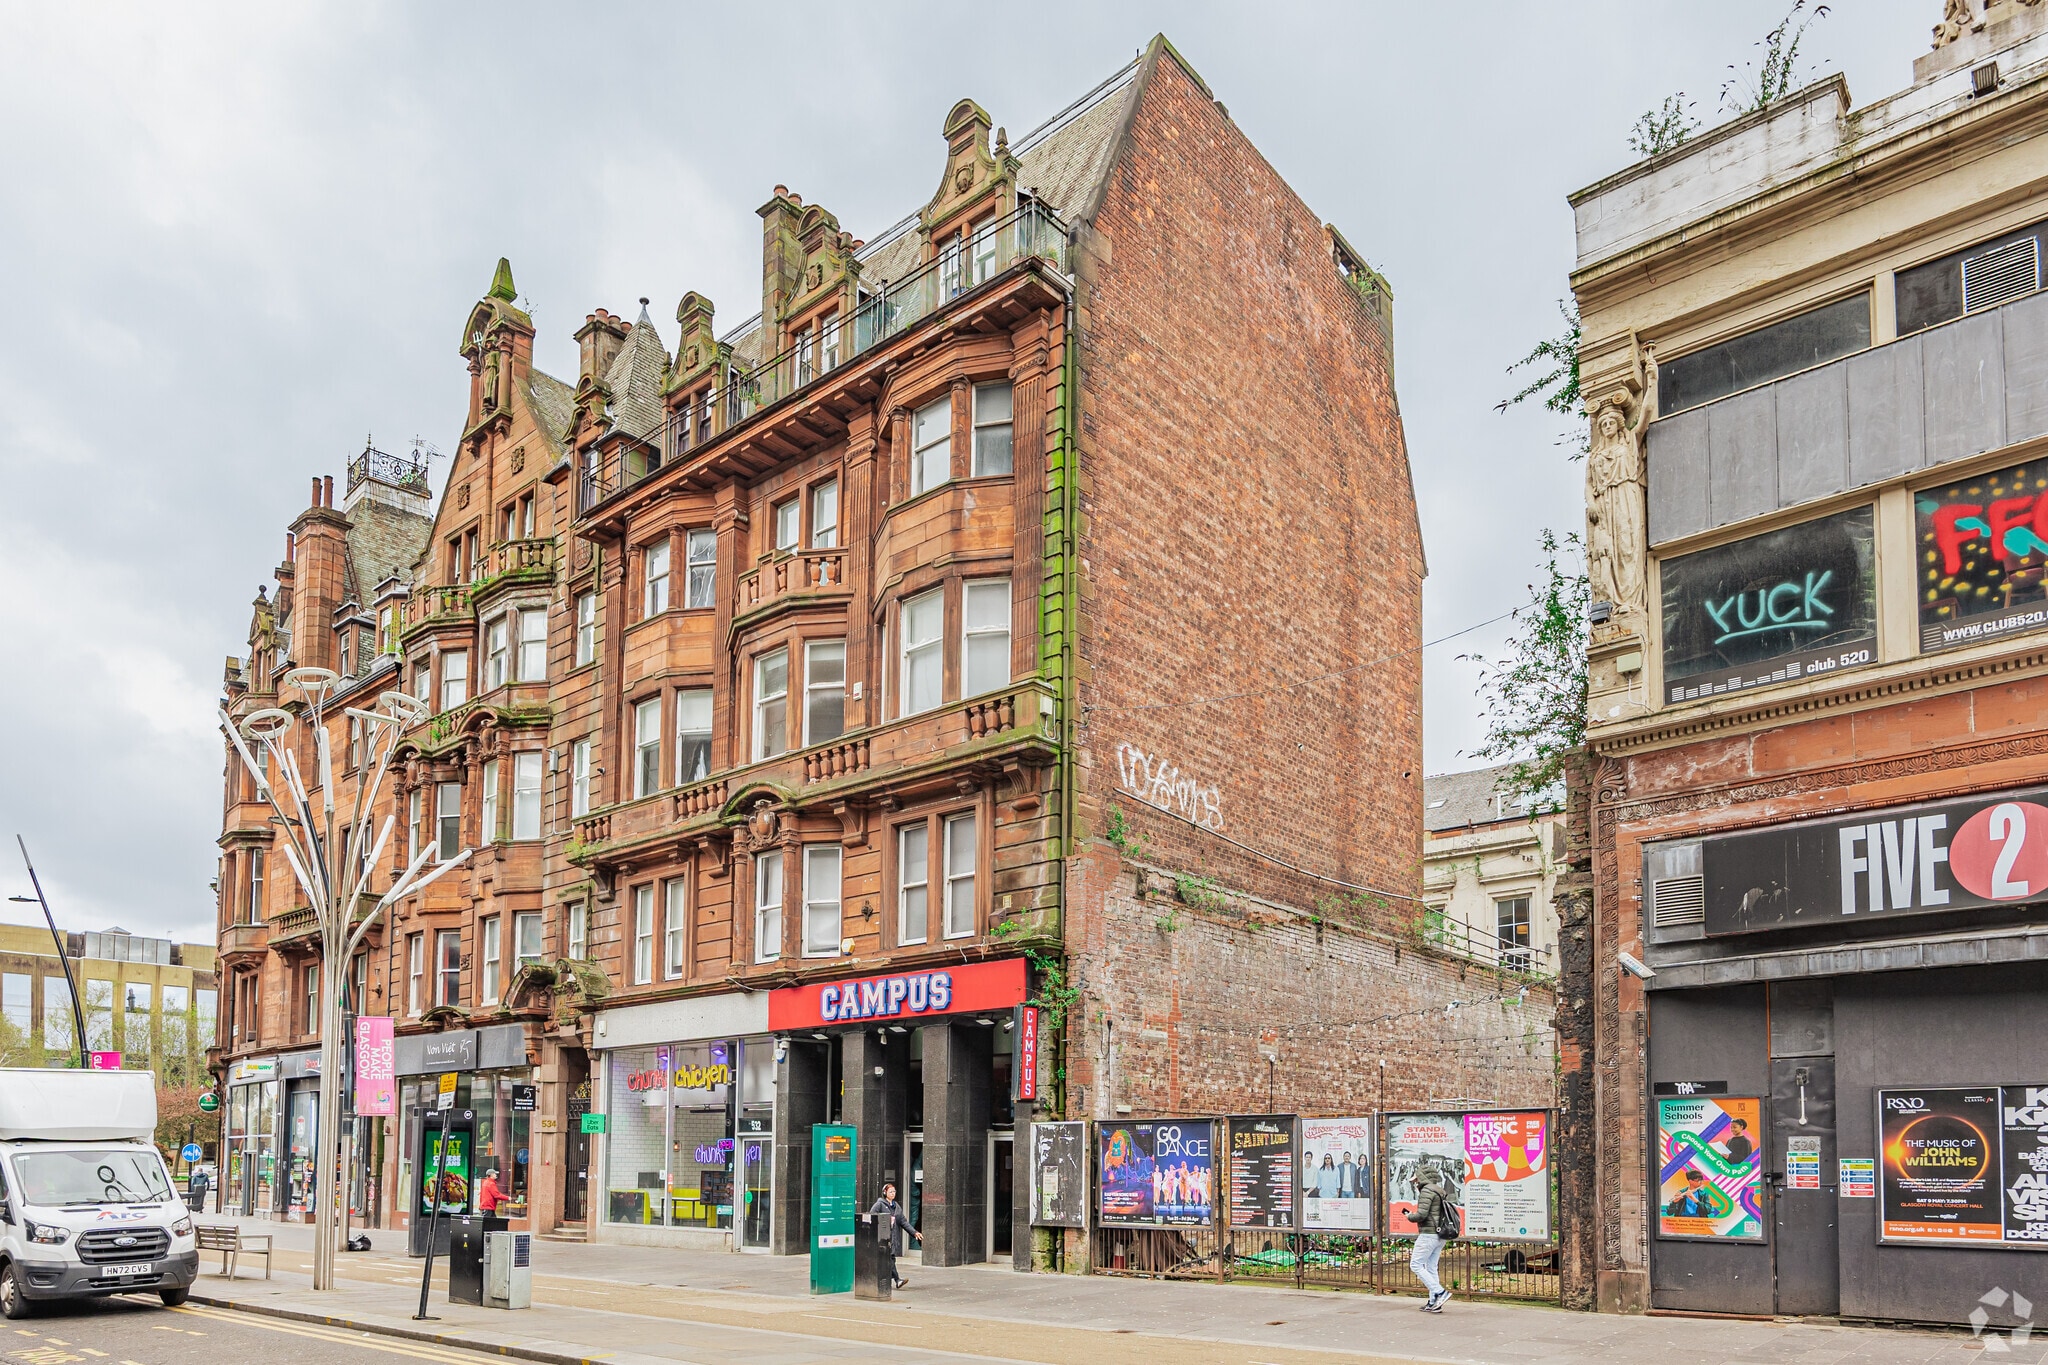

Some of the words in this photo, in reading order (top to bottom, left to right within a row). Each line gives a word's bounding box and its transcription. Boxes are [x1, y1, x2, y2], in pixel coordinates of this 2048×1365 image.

[1706, 570, 1833, 633] YUCK
[1943, 611, 2048, 640] WWW.CLUB520.
[1807, 658, 1835, 674] club
[1841, 650, 1869, 666] 520
[1839, 813, 1950, 914] FIVE
[821, 971, 953, 1021] CAMPUS
[360, 1022, 370, 1080] GLASGOW
[1025, 1010, 1034, 1096] CAMPUS
[370, 1048, 381, 1080] MAKE
[382, 1039, 392, 1080] PEOPLE
[675, 1064, 728, 1092] chicken
[1886, 1098, 1924, 1109] RSNO
[542, 1120, 557, 1128] 534
[750, 1120, 761, 1130] 532
[1469, 1122, 1518, 1134] MUSIC
[1157, 1126, 1182, 1142] GO
[1470, 1134, 1500, 1146] DAY
[433, 1140, 462, 1148] NXT
[1157, 1140, 1208, 1156] DANCE
[1681, 1133, 1704, 1151] Choose
[1793, 1141, 1816, 1150] 520
[1704, 1148, 1717, 1163] Your
[1921, 1148, 1960, 1156] JOHN
[1716, 1160, 1730, 1174] Own
[1905, 1157, 1977, 1166] WILLIAMS
[1732, 1165, 1748, 1175] Path
[106, 1266, 129, 1275] HN72
